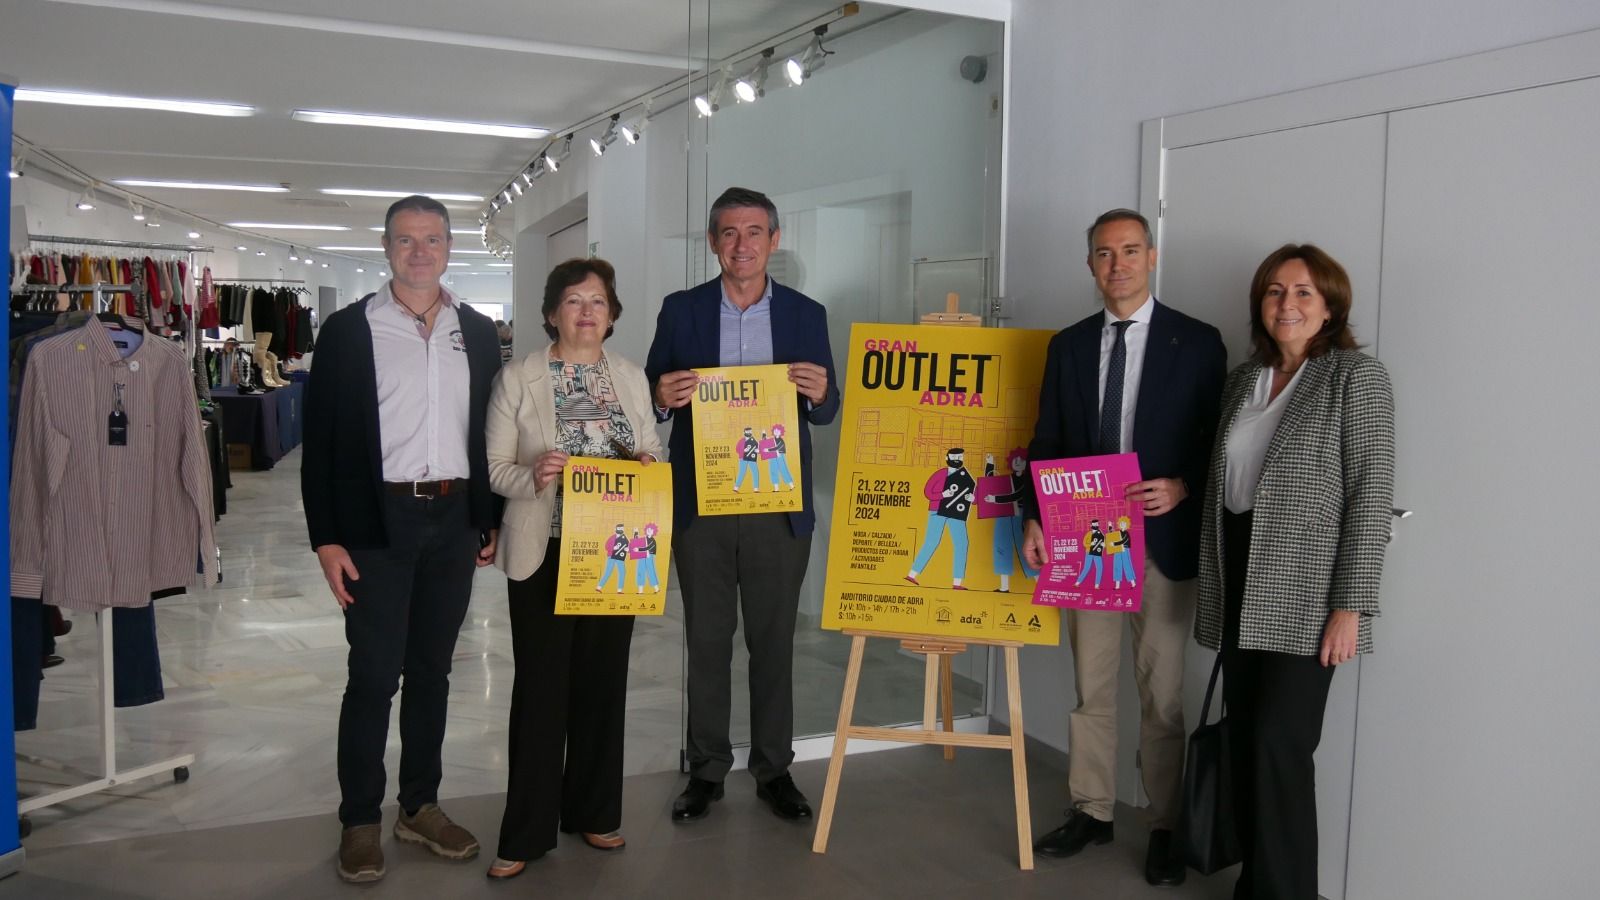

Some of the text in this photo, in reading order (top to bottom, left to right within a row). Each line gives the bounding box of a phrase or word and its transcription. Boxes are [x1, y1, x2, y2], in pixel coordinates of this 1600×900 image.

[865, 339, 917, 352] GRAN
[862, 350, 992, 393] OUTLET
[699, 380, 760, 402] OUTLET
[728, 398, 758, 408] ADRA
[919, 391, 983, 407] ADRA
[572, 464, 598, 473] GRAN
[1039, 467, 1065, 476] GRAN
[572, 471, 635, 496] OUTLET
[857, 478, 910, 493] 21, 22 Y 23
[1040, 470, 1102, 495] OUTLET
[602, 493, 633, 502] ADRA
[856, 493, 911, 507] NOVIEMBRE
[1072, 491, 1103, 500] ADRA
[855, 507, 880, 520] 2024
[871, 531, 892, 539] CALZADO
[878, 540, 898, 548] BELLEZA
[851, 547, 878, 555] PRODUCTOS
[840, 592, 924, 606] AUDITORIO CIUDAD DE ADRA
[906, 606, 917, 615] 21h
[960, 614, 982, 624] adra
